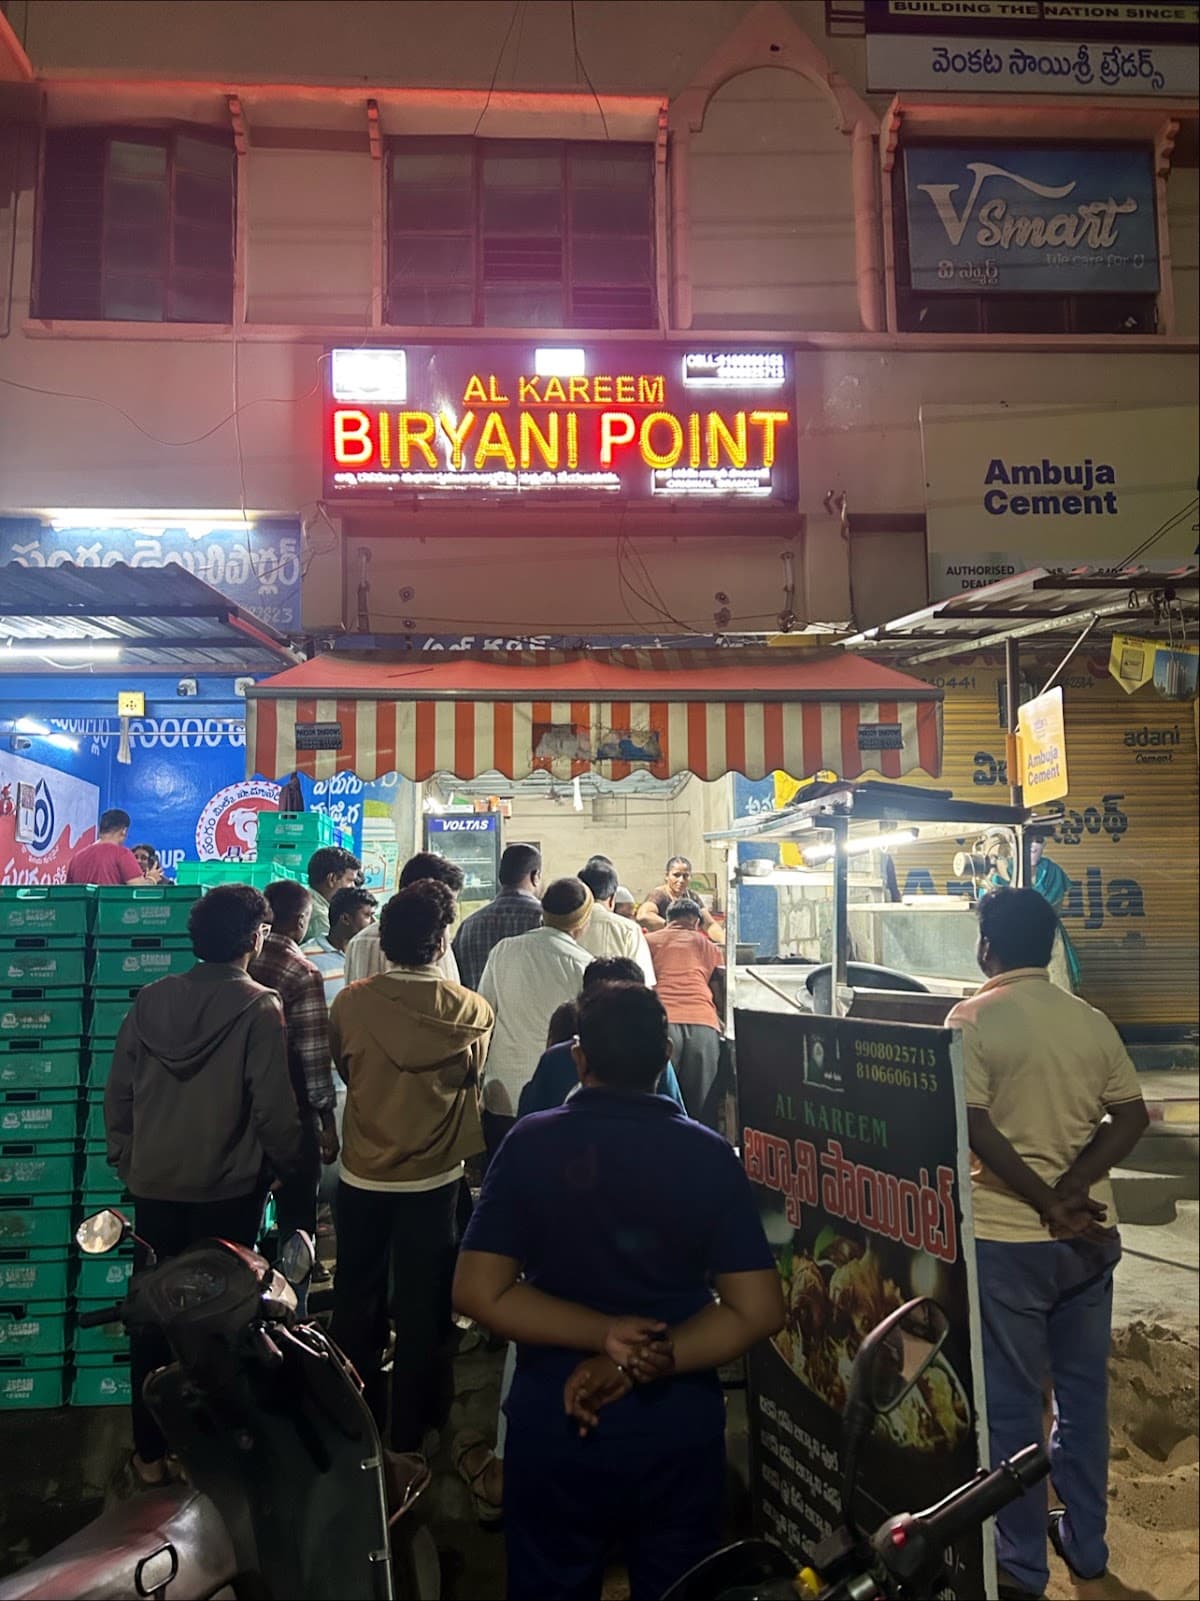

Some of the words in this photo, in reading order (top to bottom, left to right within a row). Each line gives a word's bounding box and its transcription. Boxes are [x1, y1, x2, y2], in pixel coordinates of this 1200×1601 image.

[894, 2, 991, 14] BUILDING
[1000, 5, 1039, 15] THE
[1044, 6, 1119, 17] NATION
[1126, 8, 1185, 19] SINCE
[932, 47, 1002, 74] వెంకట
[1008, 44, 1094, 85] సాయిశ్రీ
[1099, 47, 1165, 89] ట్రేడర్స్
[463, 376, 509, 403] AL
[518, 375, 665, 403] KAREEM
[333, 409, 579, 469] BIRYANI
[601, 410, 789, 469] POINT
[984, 459, 1115, 491] Ambuja
[984, 489, 1118, 515] Cement
[946, 566, 1015, 576] AUTHORISED
[961, 579, 999, 589] DEALE
[1124, 725, 1180, 746] adani
[1027, 746, 1058, 769] Ambuja
[1027, 764, 1060, 786] Cement
[442, 819, 489, 831] VOLTAS
[855, 1040, 936, 1067] 9908025713
[856, 1062, 938, 1092] 8106606153
[776, 1093, 796, 1120] AL
[803, 1100, 888, 1149] KAREEM
